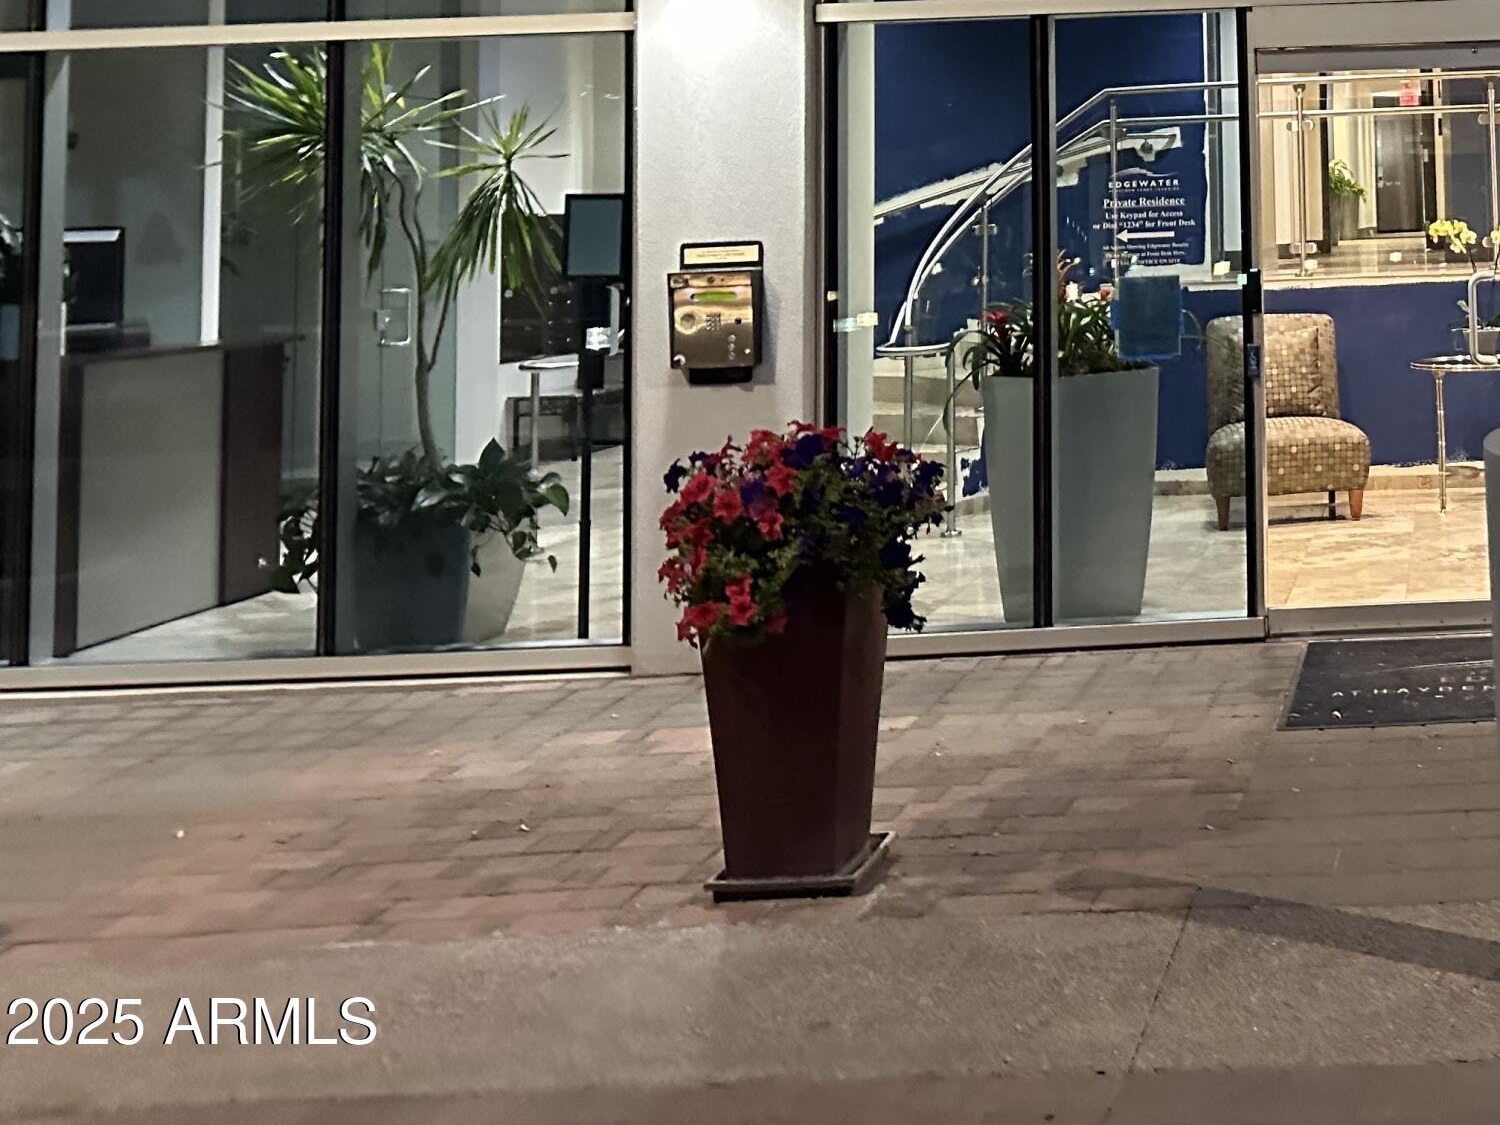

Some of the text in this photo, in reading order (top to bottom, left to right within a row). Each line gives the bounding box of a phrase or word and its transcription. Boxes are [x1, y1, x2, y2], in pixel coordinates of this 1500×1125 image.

[1108, 179, 1179, 188] EDGEWATER
[1103, 197, 1185, 208] Private Residence
[1120, 211, 1147, 220] Keypad
[1149, 210, 1158, 218] for
[1157, 219, 1177, 227] Front
[1178, 218, 1196, 226] Desk
